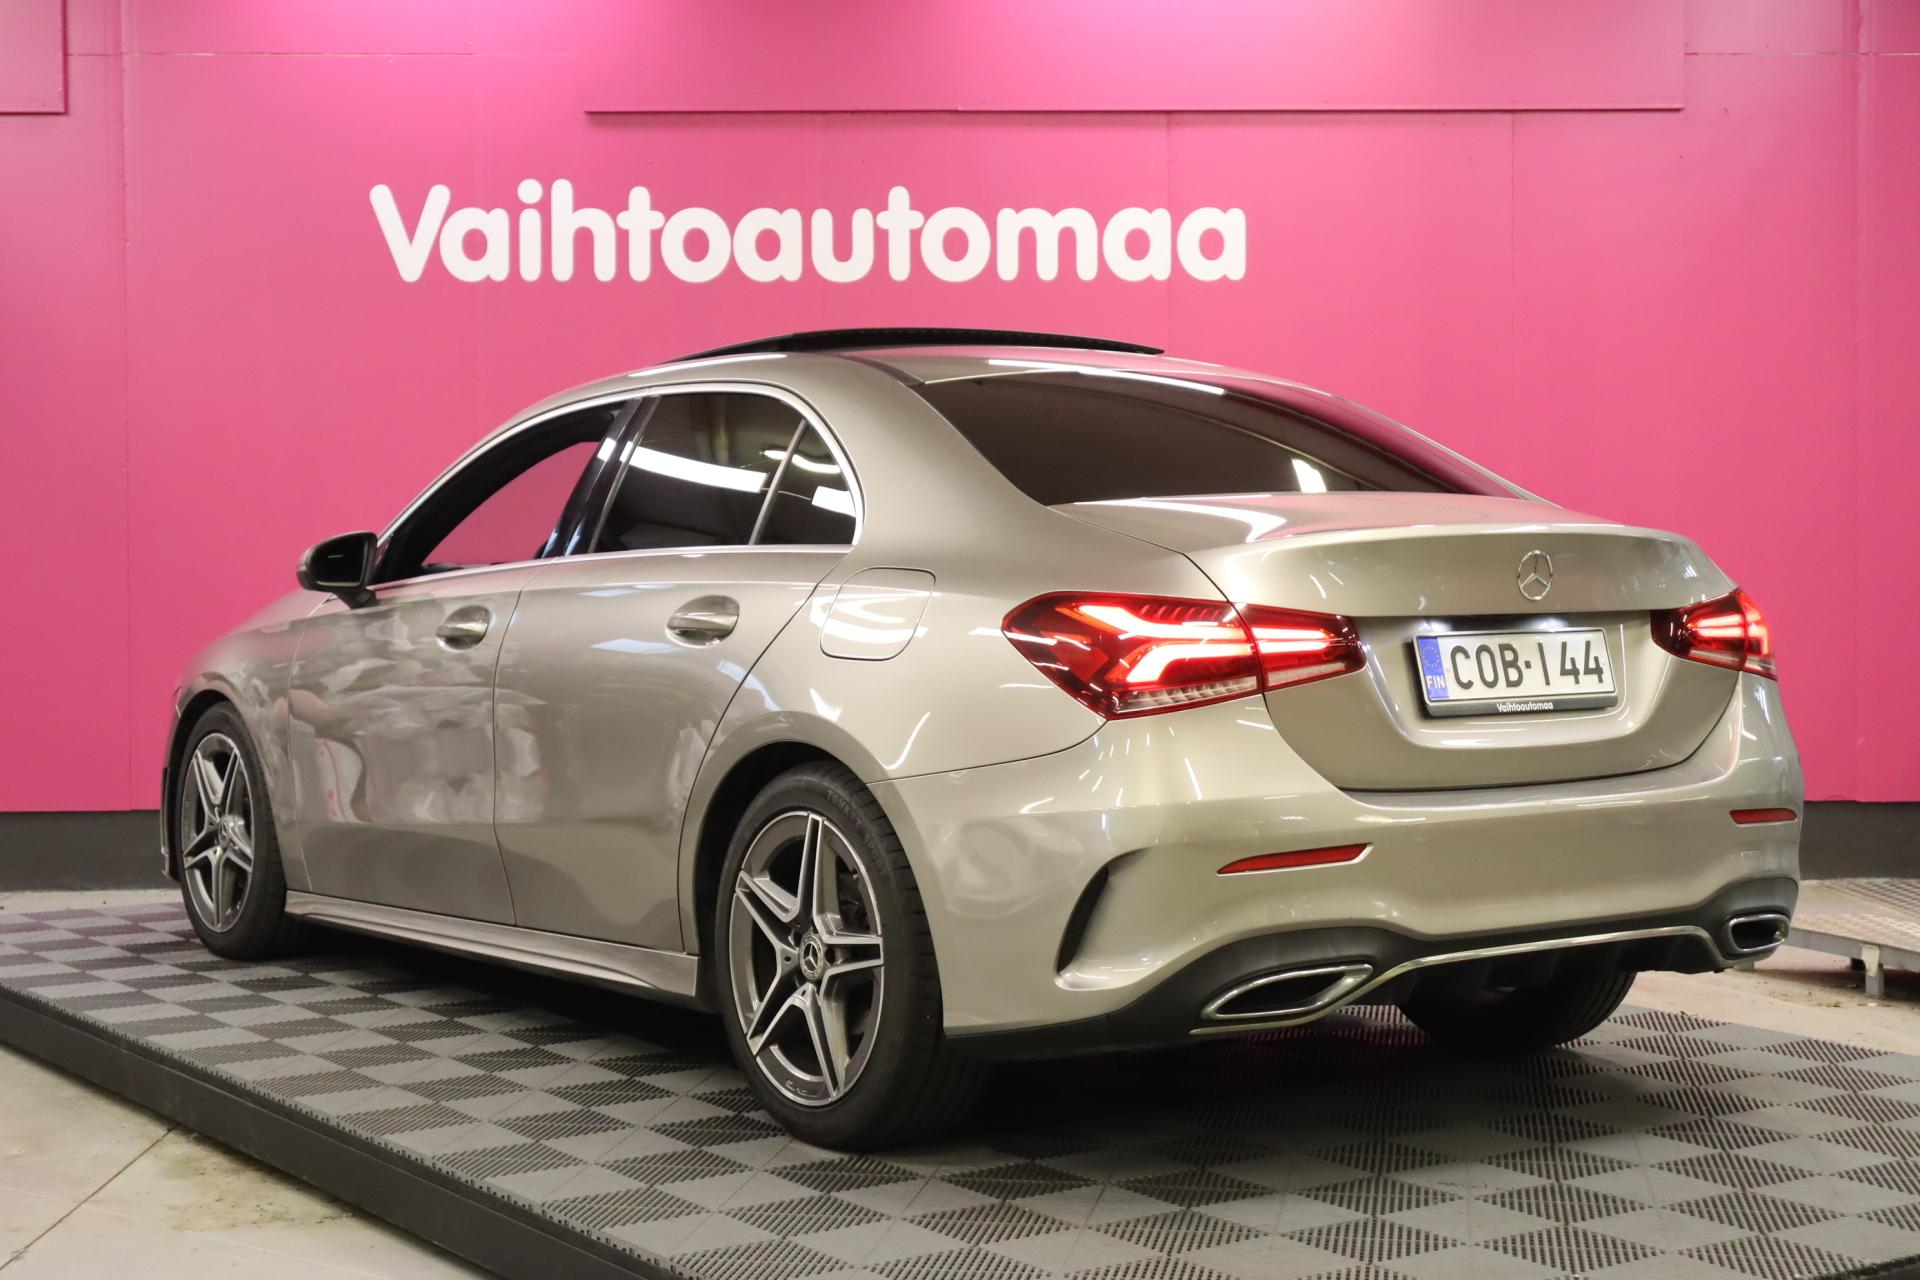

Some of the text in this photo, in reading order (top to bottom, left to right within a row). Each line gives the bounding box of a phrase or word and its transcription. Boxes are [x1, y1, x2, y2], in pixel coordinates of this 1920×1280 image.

[369, 178, 1247, 283] Vaihtoautomaa
[1426, 674, 1446, 689] FIN
[1496, 701, 1553, 713] Vaihtoautomaa
